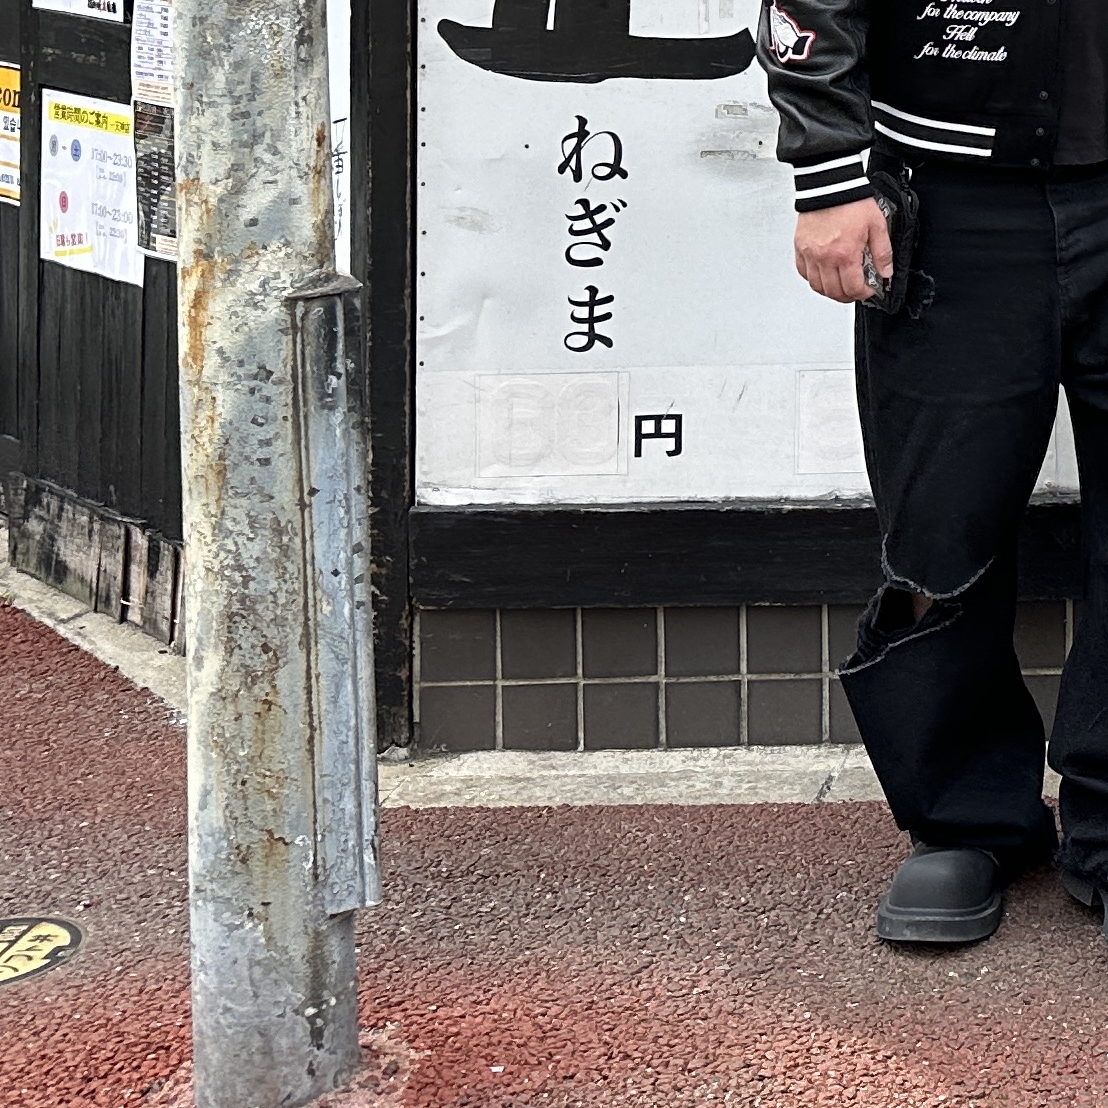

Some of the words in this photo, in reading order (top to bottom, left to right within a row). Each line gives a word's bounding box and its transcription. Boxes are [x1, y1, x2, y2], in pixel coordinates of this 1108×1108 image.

[917, 2, 940, 20] for
[943, 3, 963, 20] the
[962, 8, 1020, 26] company
[942, 24, 976, 42] Hell
[914, 42, 939, 59] for
[941, 43, 962, 59] the
[962, 45, 1008, 62] climate
[557, 114, 629, 353] ねぎま
[634, 413, 682, 458] 円
